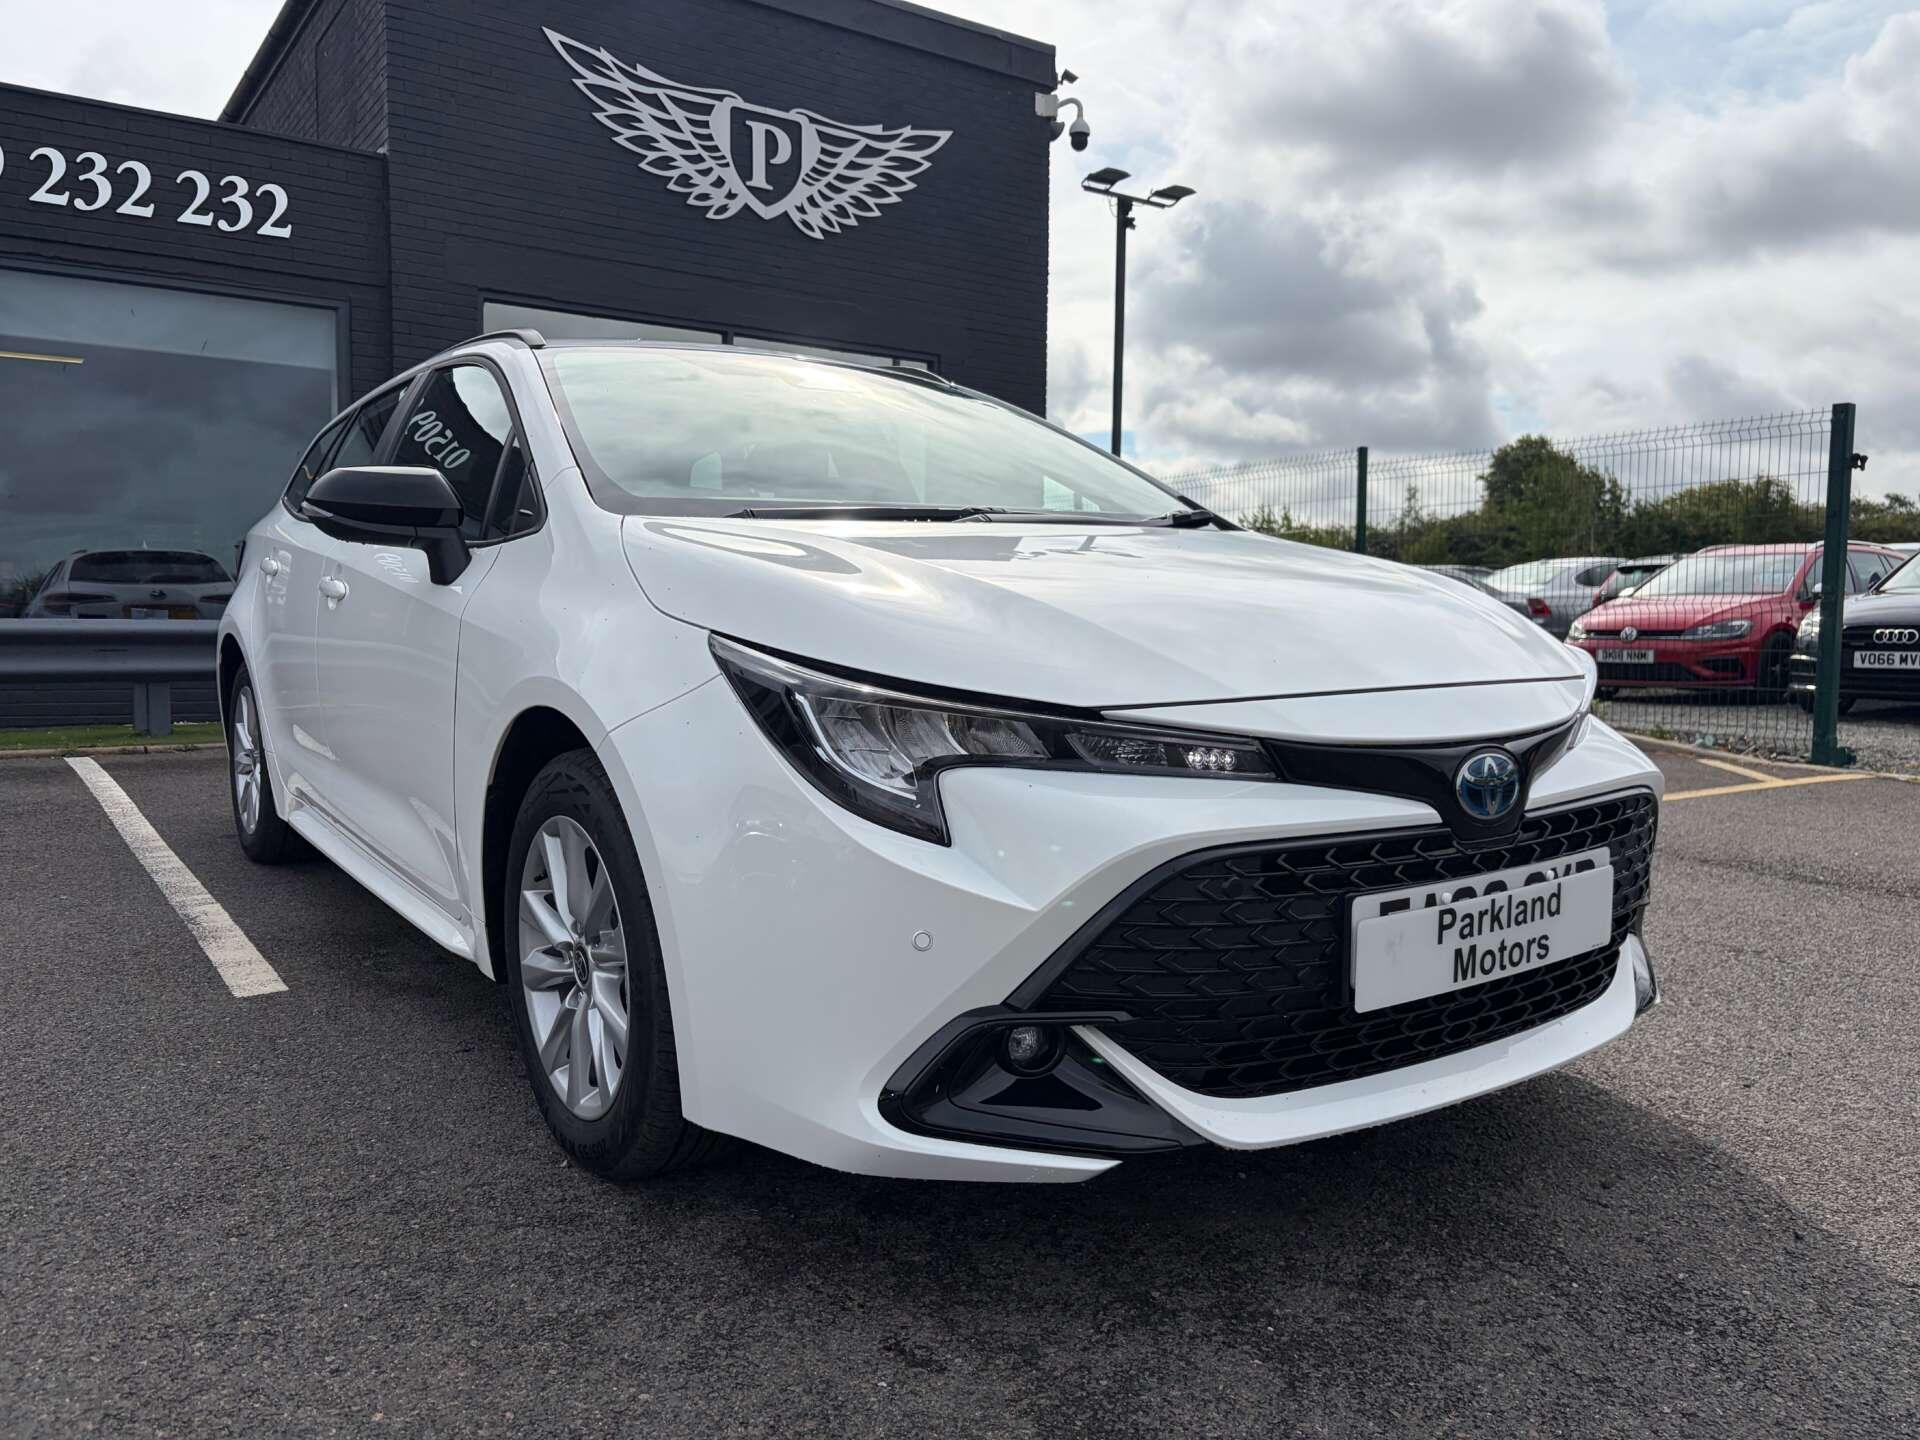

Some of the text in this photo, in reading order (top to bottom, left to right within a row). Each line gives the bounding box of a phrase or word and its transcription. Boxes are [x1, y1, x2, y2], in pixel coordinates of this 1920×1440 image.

[745, 120, 792, 191] P
[28, 146, 155, 218] 232
[175, 169, 293, 239] 232
[1899, 653, 1920, 667] MV
[1437, 882, 1562, 945] Parkland
[1453, 933, 1550, 984] Motors
